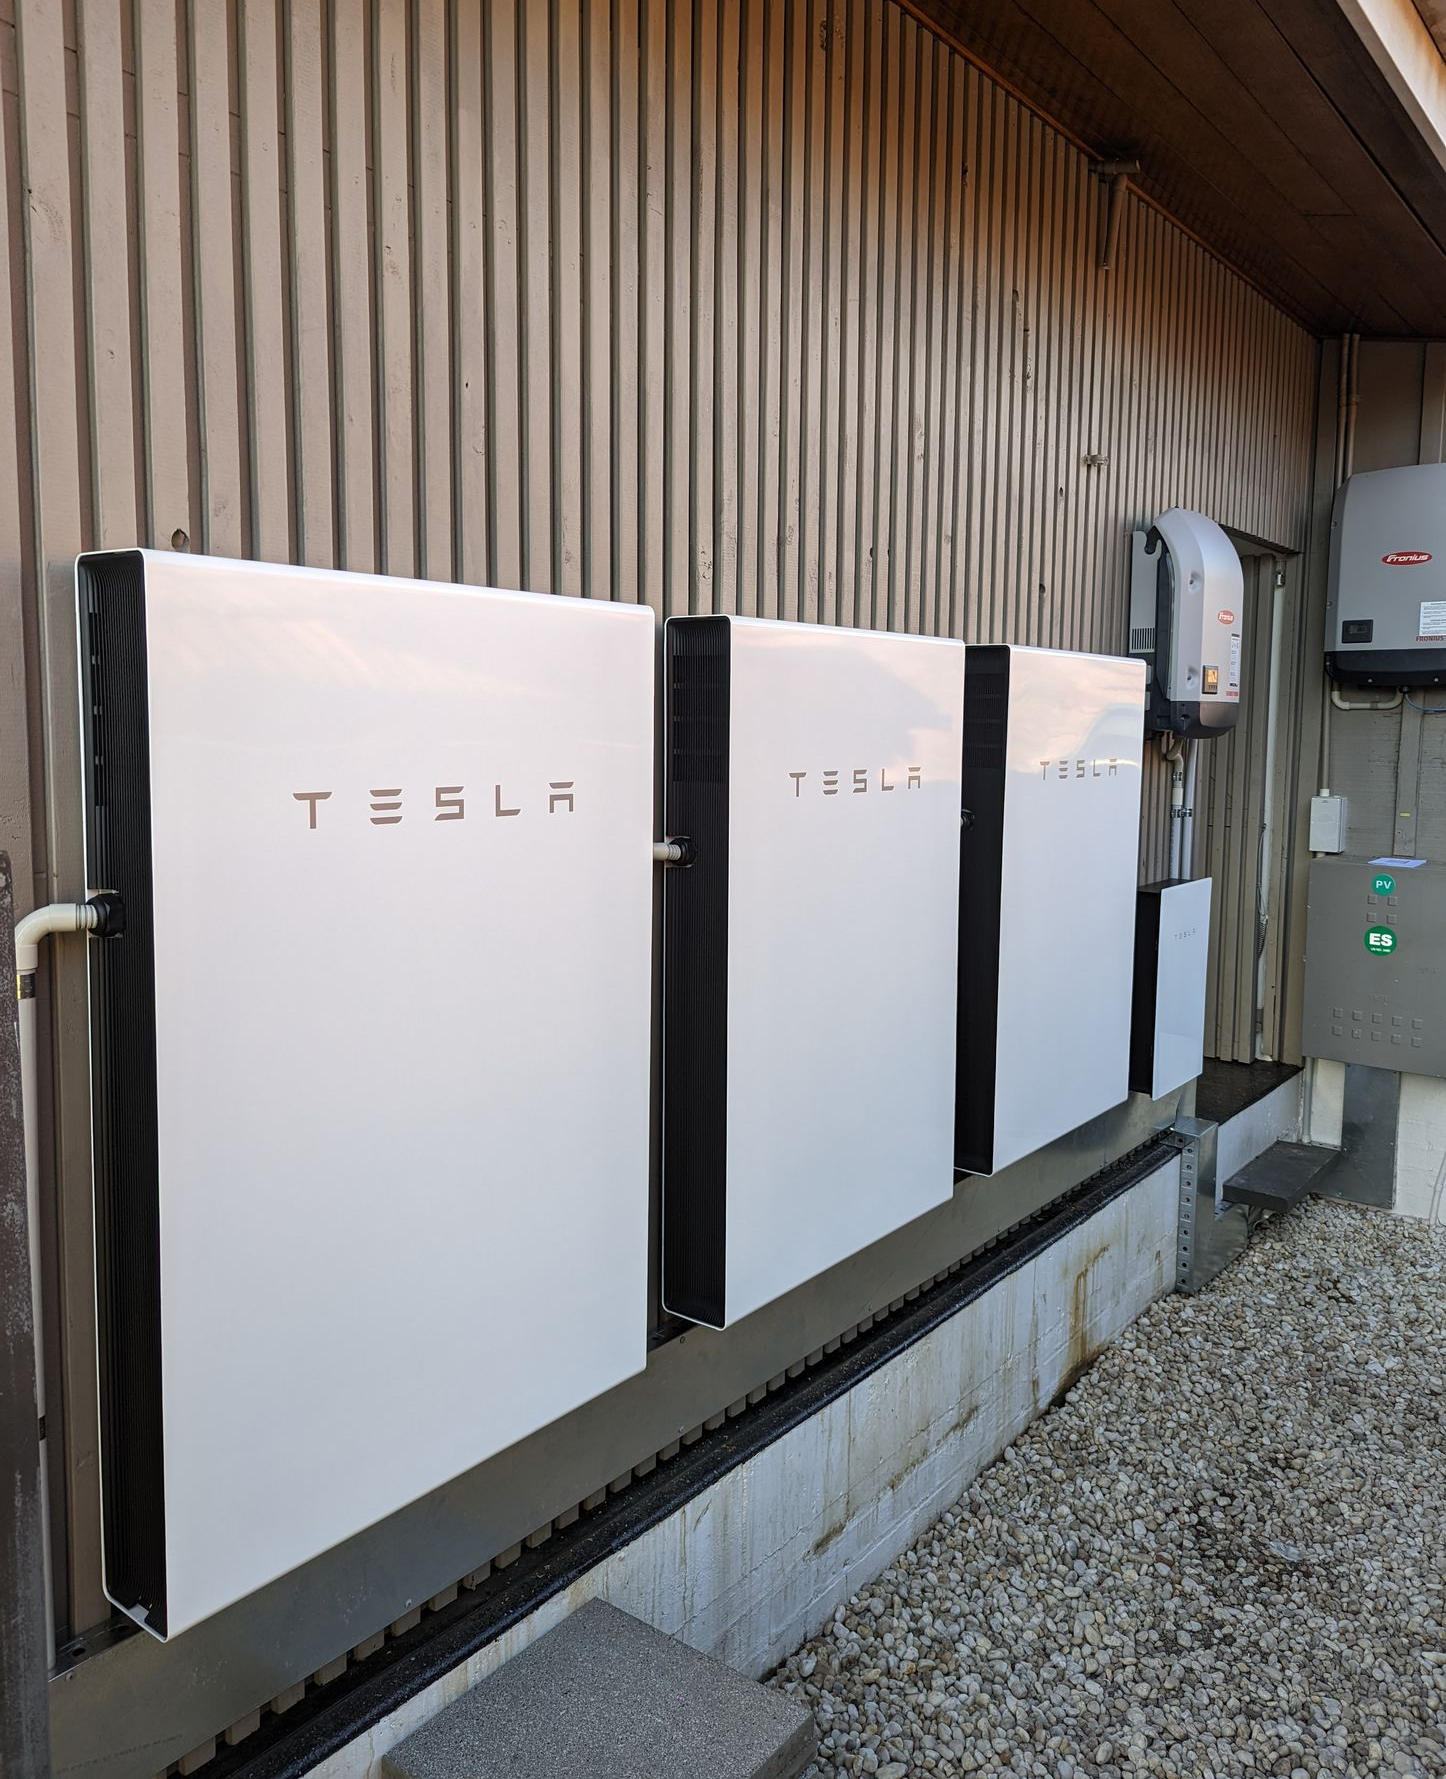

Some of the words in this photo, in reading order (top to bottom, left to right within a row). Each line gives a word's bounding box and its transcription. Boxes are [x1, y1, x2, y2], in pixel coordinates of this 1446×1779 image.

[1387, 554, 1429, 562] Fronius
[1040, 758, 1118, 780] TESLA
[788, 766, 921, 797] TESLA
[292, 781, 575, 829] TESLA
[1375, 880, 1392, 889] PV
[1369, 933, 1393, 947] ES
